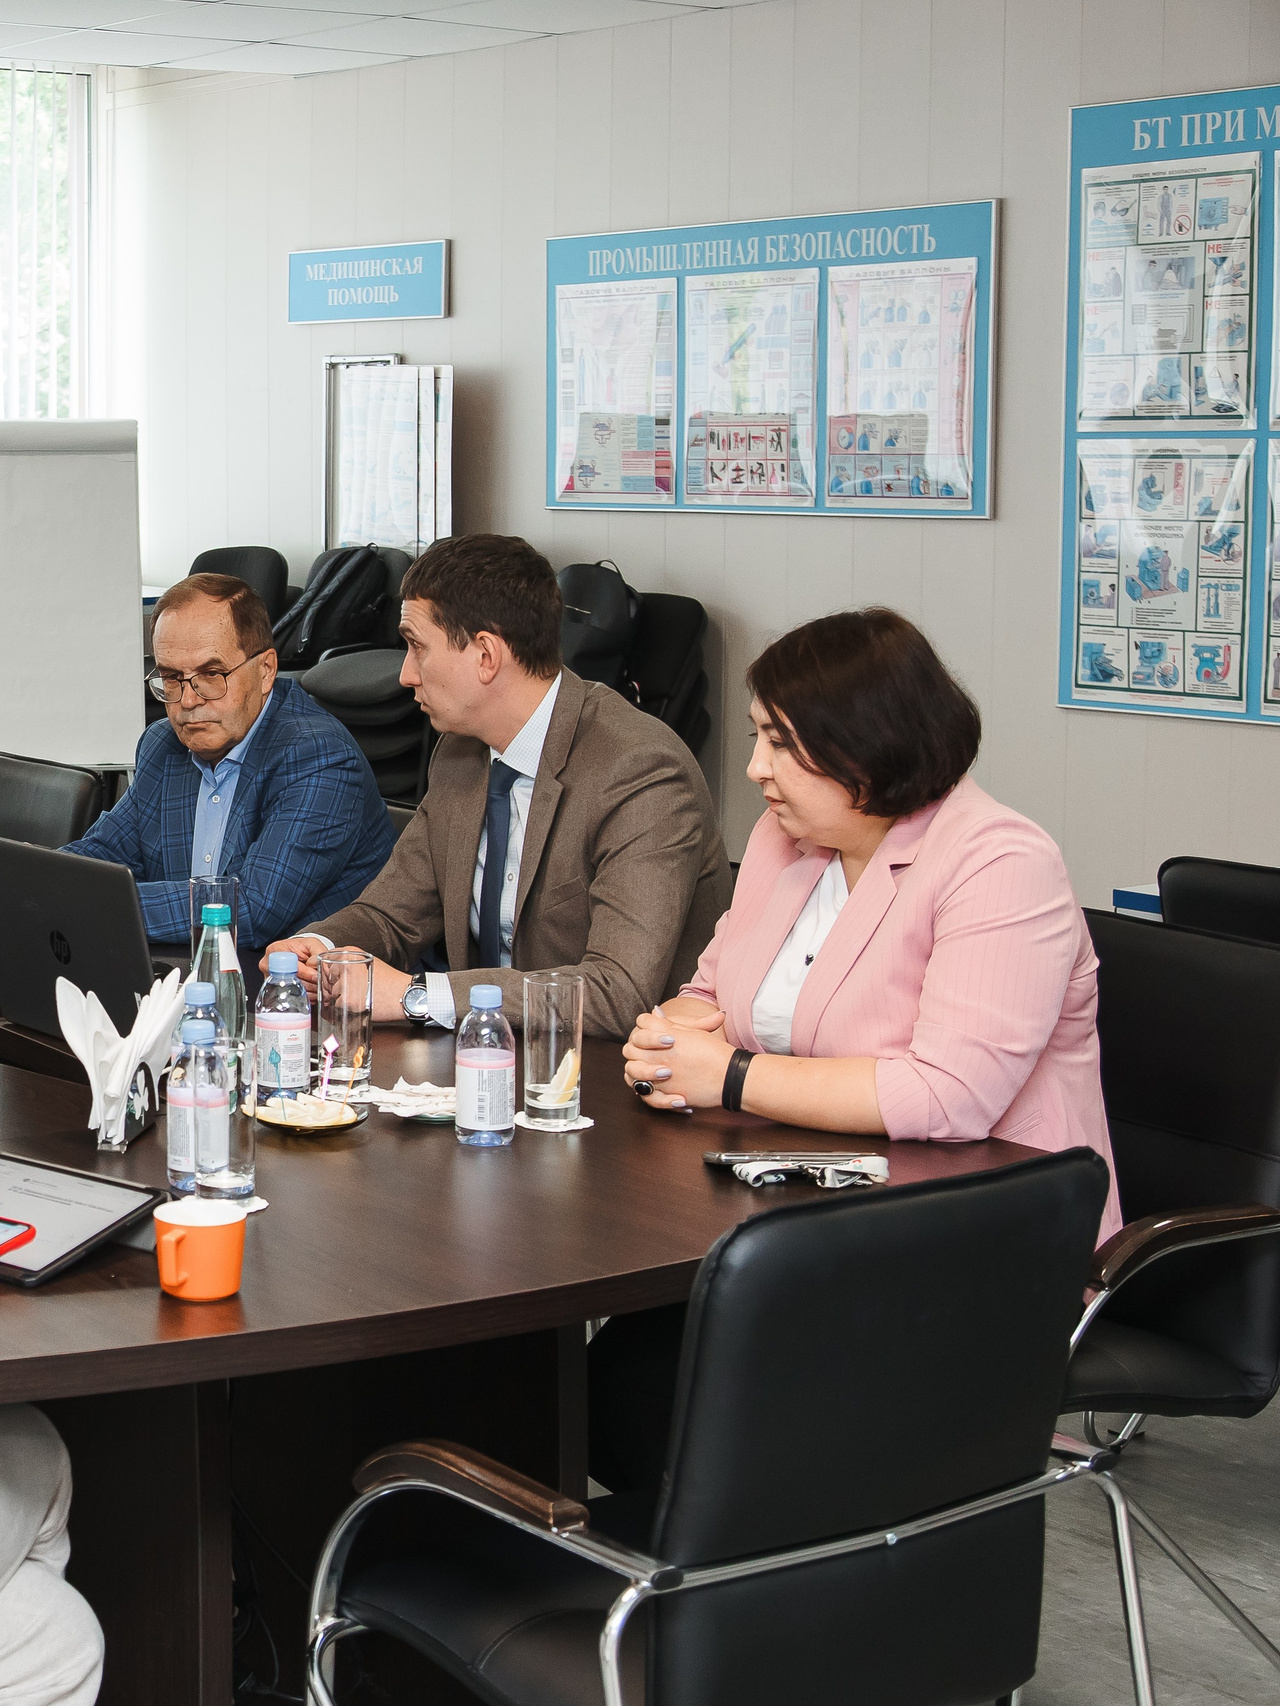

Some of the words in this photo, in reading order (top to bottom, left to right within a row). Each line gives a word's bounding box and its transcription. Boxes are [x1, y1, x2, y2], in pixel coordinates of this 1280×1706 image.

[1132, 117, 1171, 151] БТ
[1179, 109, 1246, 146] ПРИ
[588, 237, 759, 276] ПРОМЫШЛЕННАЯ
[765, 224, 936, 264] БЕЗОПАСНОСТЬ
[1207, 244, 1222, 254] НЕ
[306, 256, 423, 282] МЕДИЦИНСКАЯ
[328, 285, 399, 306] ПОМОЩЬ
